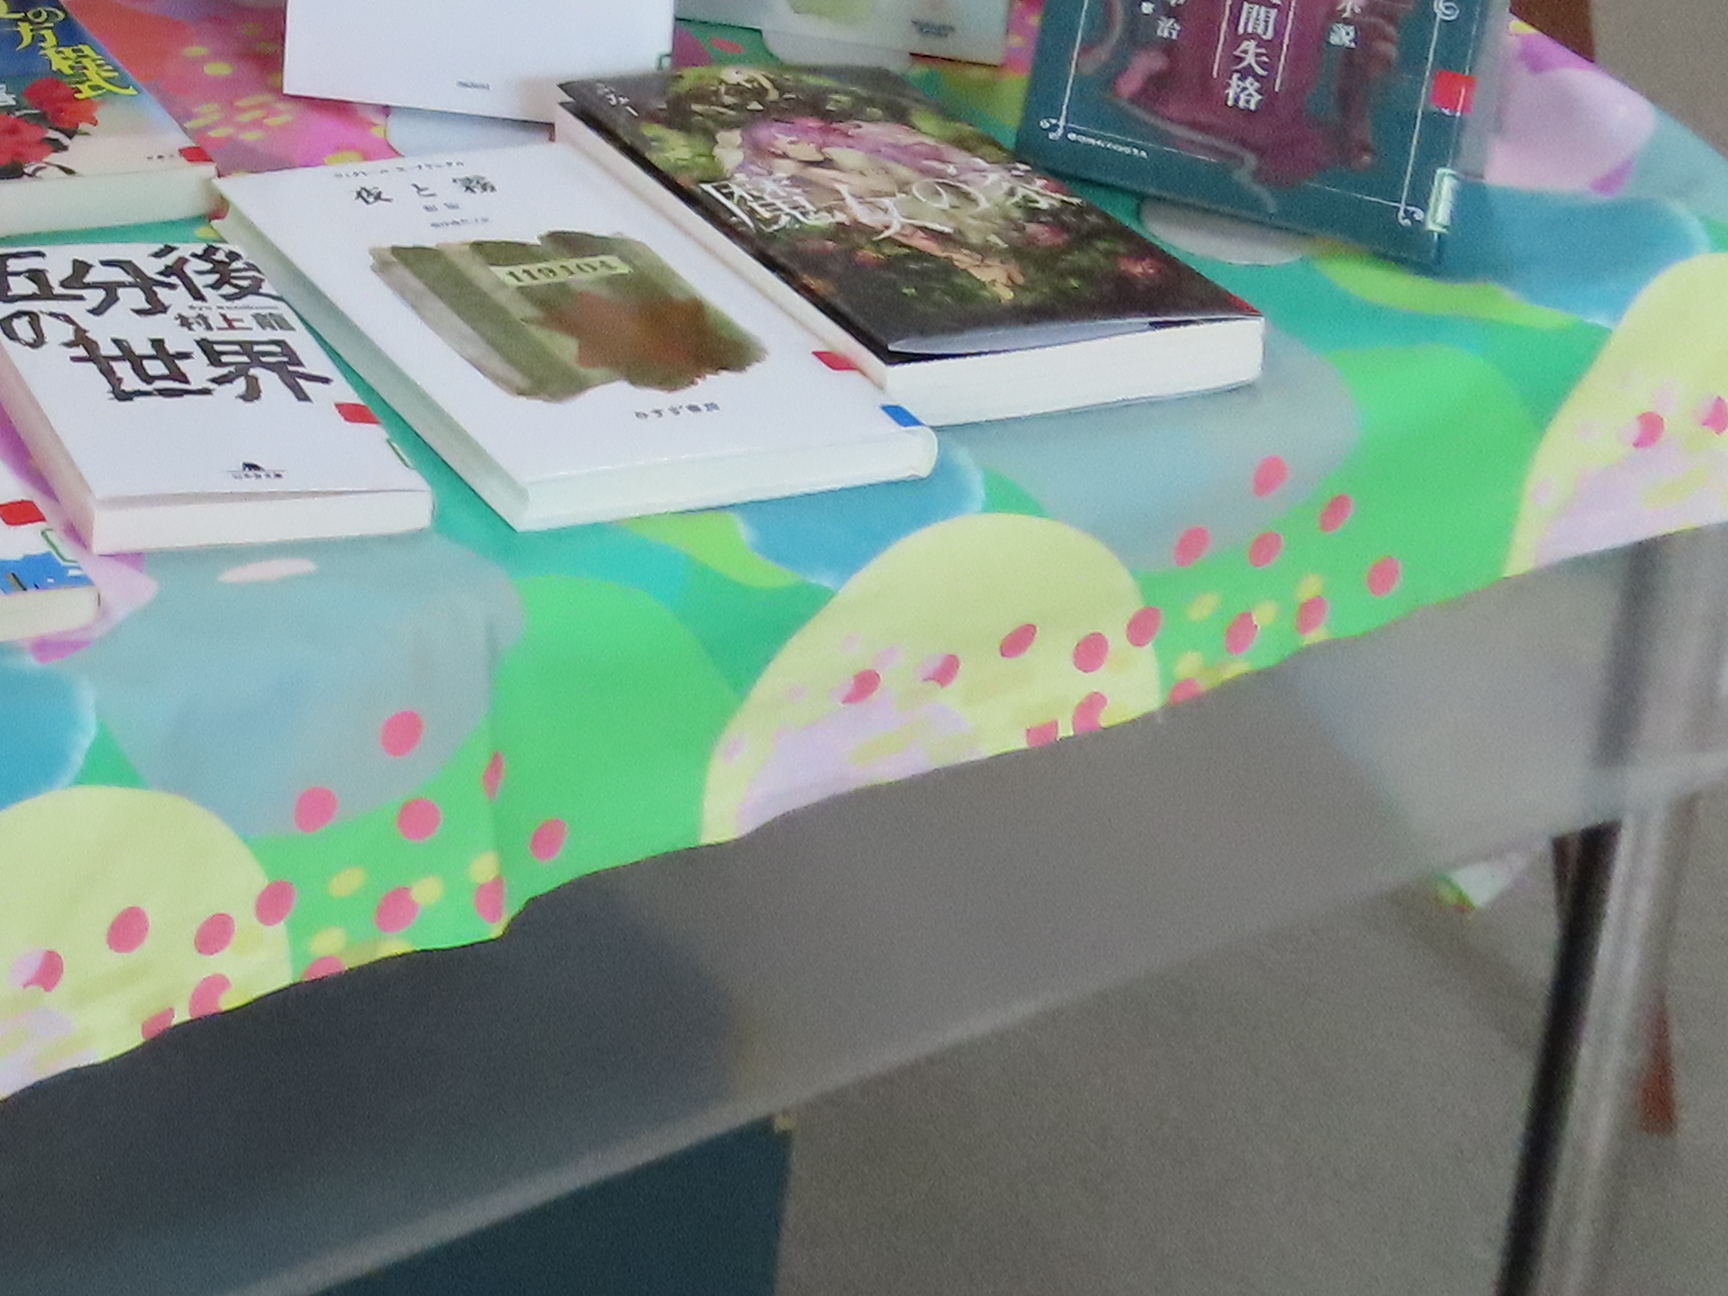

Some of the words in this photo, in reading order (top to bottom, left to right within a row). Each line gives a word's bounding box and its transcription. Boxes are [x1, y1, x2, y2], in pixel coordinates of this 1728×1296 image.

[352, 174, 498, 206] 夜と霧
[174, 310, 298, 336] 村上龍
[0, 309, 333, 404] の世界
